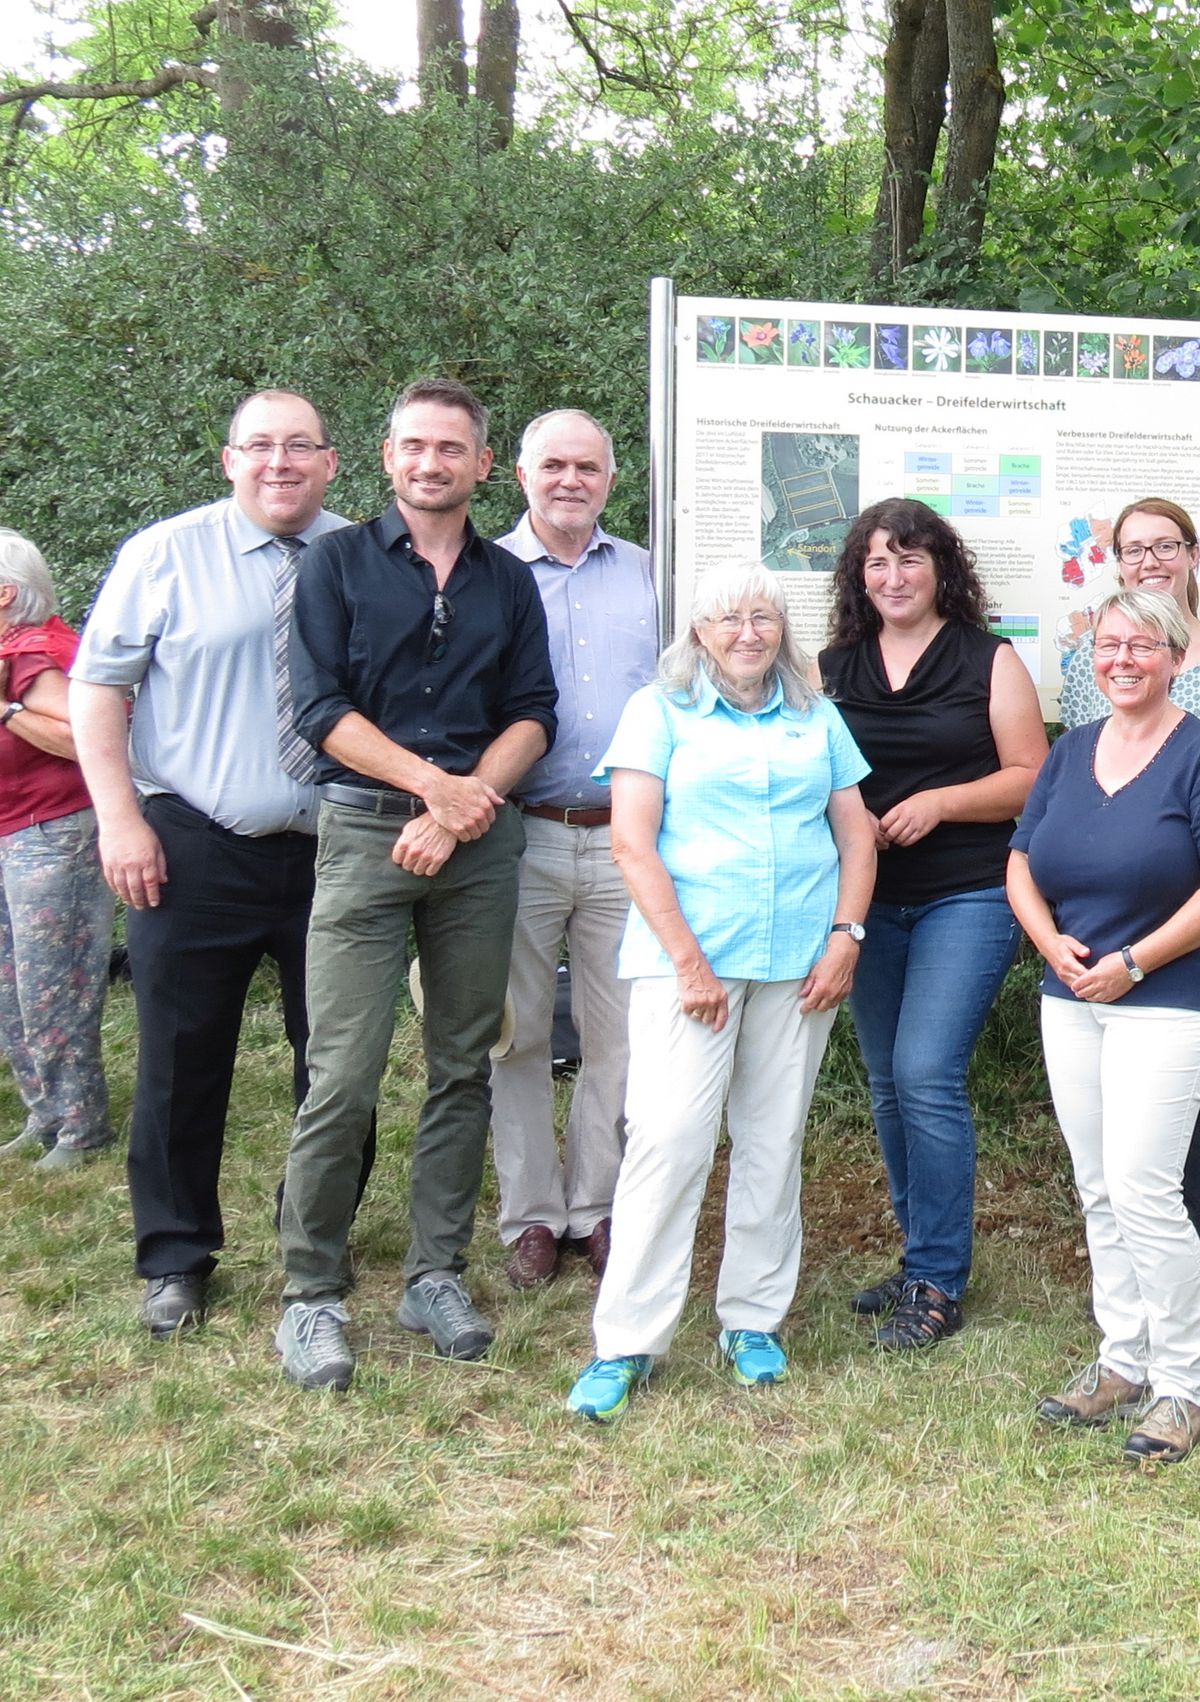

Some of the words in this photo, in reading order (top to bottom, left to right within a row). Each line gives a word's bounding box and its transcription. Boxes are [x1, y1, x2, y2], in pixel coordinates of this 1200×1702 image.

[848, 392, 923, 406] Schauacker
[936, 395, 1067, 411] Dreifelderwirtschaft
[696, 418, 748, 427] Historische
[749, 419, 841, 430] Dreifelderwirtschaft
[874, 423, 913, 434] Nutzung
[915, 425, 929, 433] der
[931, 425, 988, 435] Ackerflächen
[1057, 430, 1107, 439] Verbesserte
[1108, 431, 1193, 441] Dreifelderwirtschaft
[797, 544, 836, 553] Standort
